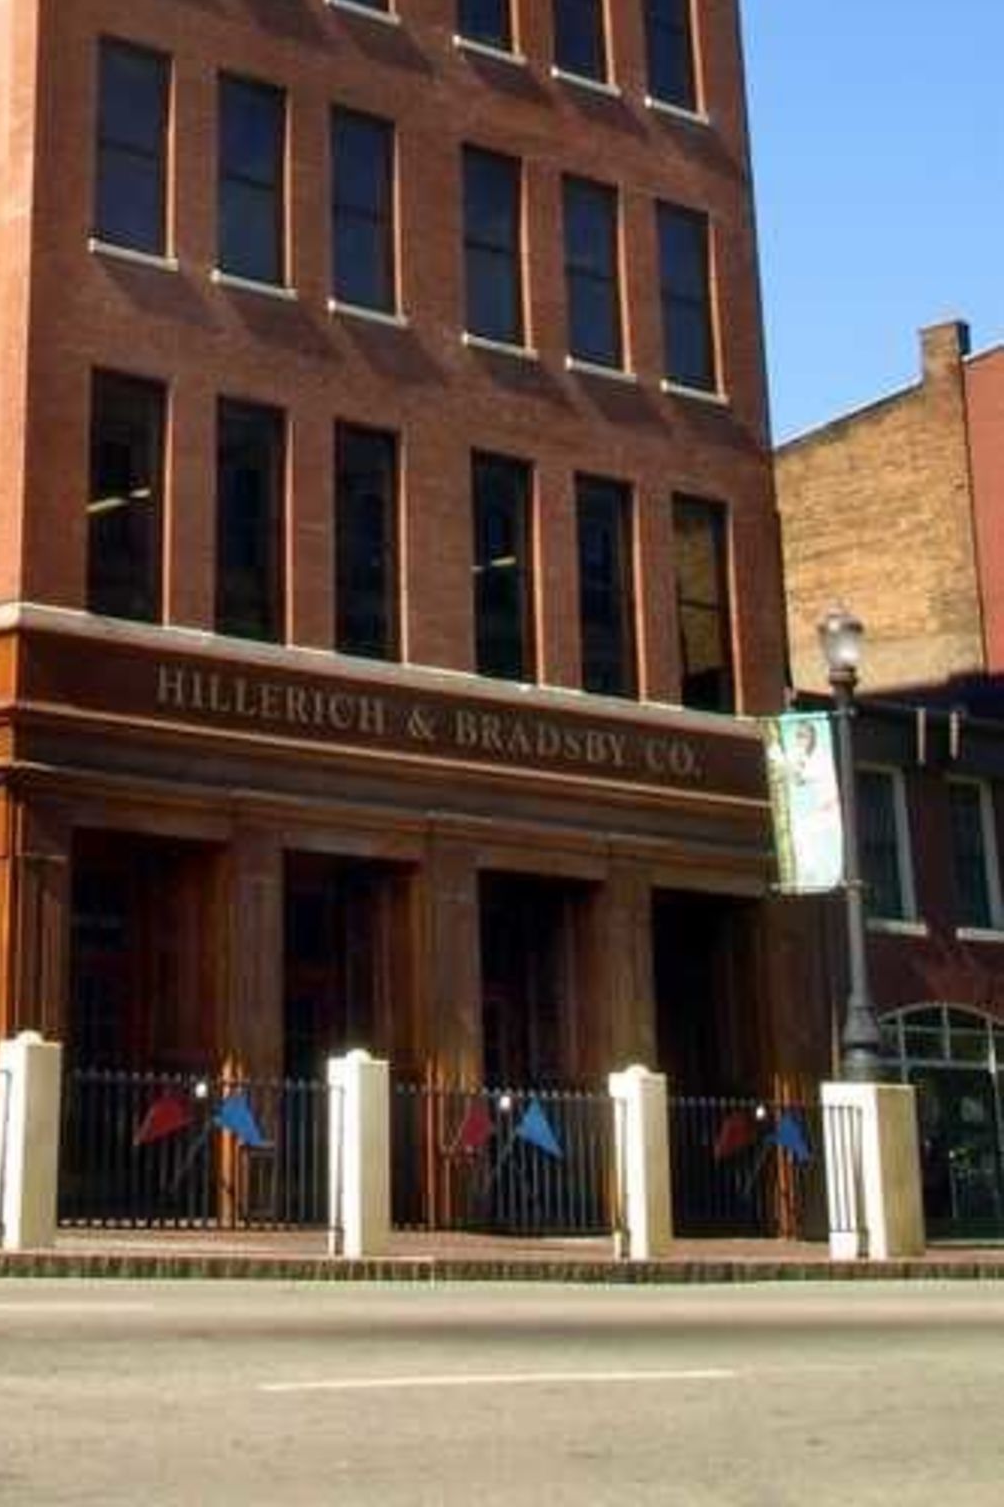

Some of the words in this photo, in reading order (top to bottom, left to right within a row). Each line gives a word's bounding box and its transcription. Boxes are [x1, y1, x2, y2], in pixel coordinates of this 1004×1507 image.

[157, 662, 387, 735] HILLERICH
[406, 708, 436, 741] &
[454, 709, 627, 768] BRADSBY
